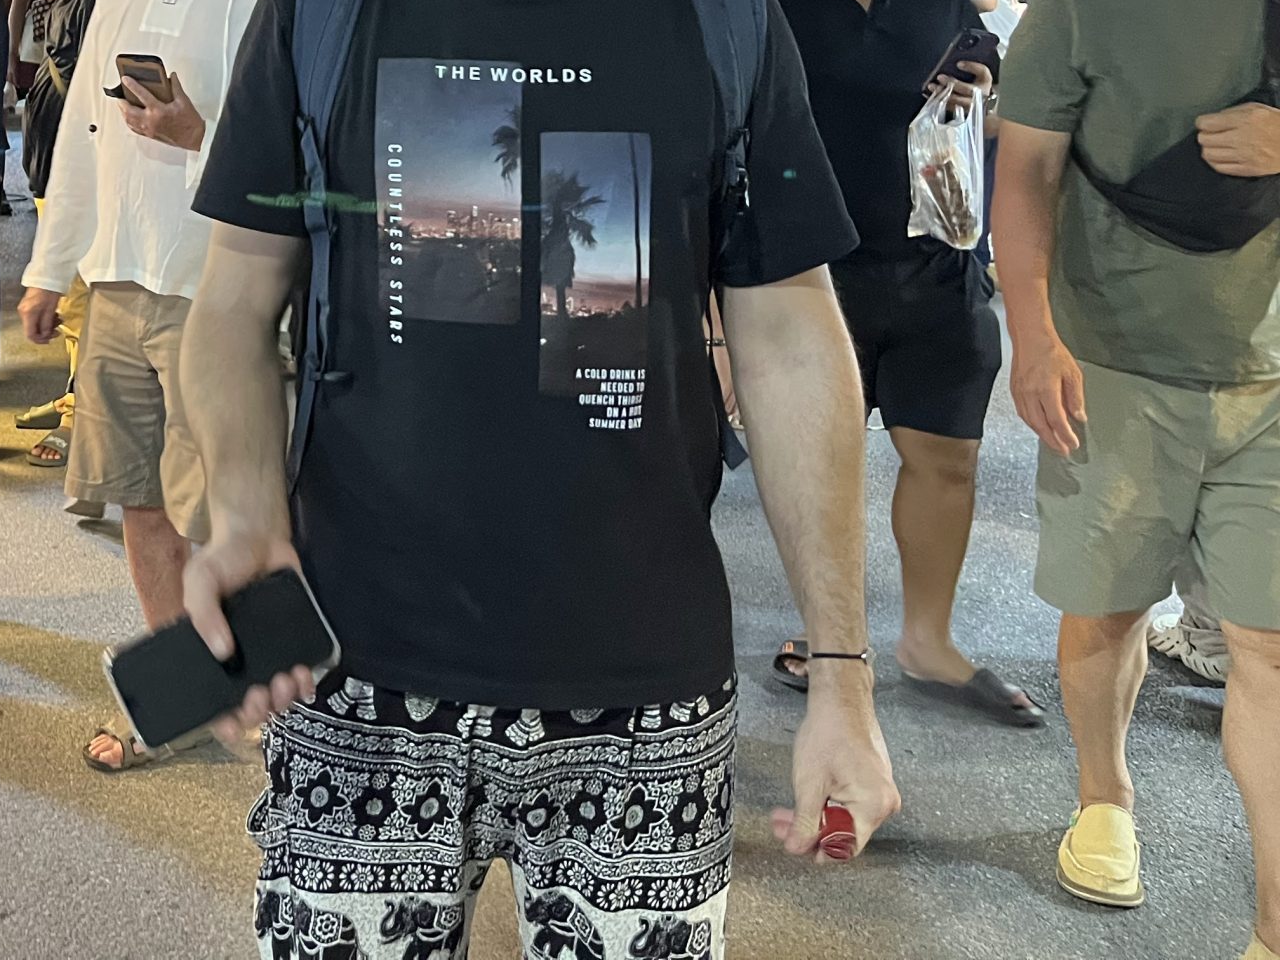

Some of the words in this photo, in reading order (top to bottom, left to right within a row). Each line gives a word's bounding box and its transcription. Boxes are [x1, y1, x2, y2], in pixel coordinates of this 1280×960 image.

[435, 65, 481, 81] THE
[491, 67, 593, 83] WORLDS
[387, 143, 403, 267] COUNTLESS
[389, 279, 403, 345] STARS
[575, 368, 582, 378] A
[584, 369, 607, 379] COLD
[609, 369, 635, 379] DRINK
[637, 369, 646, 379] IS
[600, 382, 634, 392] NEEDED
[636, 382, 645, 392] TO
[578, 394, 615, 405] QUENCH
[606, 407, 619, 418] ON
[621, 407, 627, 418] A
[589, 418, 626, 429] SUMMER
[627, 418, 643, 429] DAY
